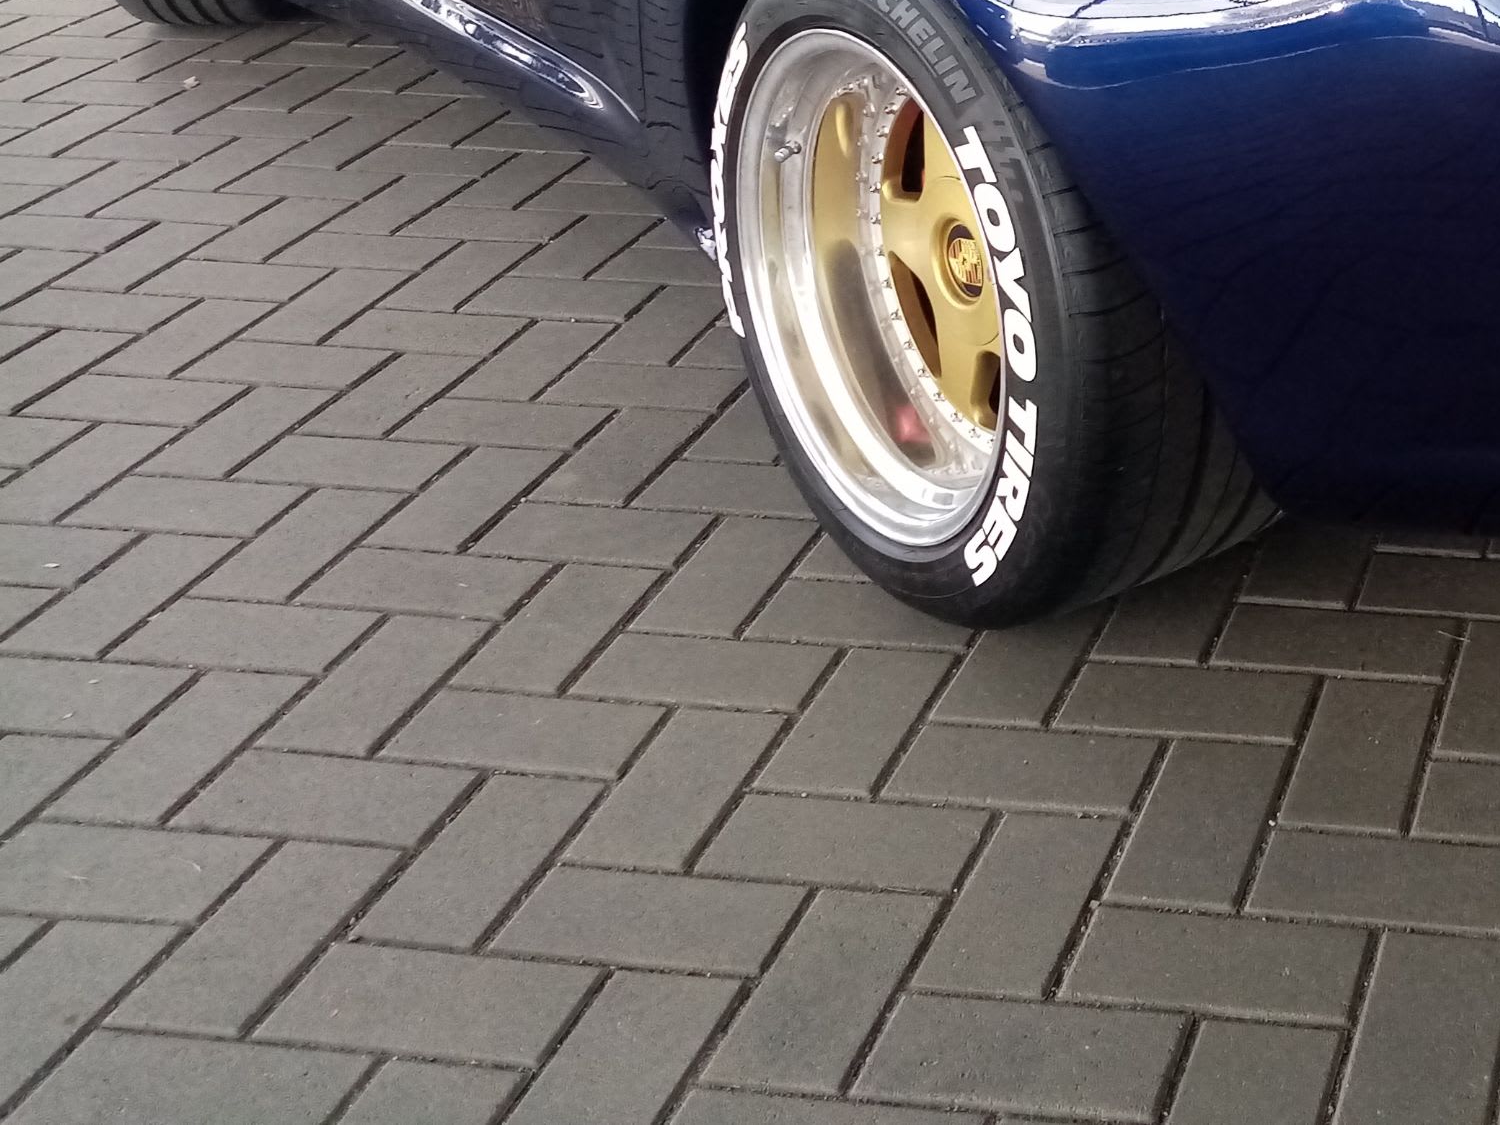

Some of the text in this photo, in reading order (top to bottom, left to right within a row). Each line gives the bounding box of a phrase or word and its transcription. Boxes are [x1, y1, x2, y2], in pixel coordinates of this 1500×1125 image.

[709, 22, 749, 338] PROXES
[950, 125, 1038, 382] TOYO
[962, 396, 1038, 587] TIRES
